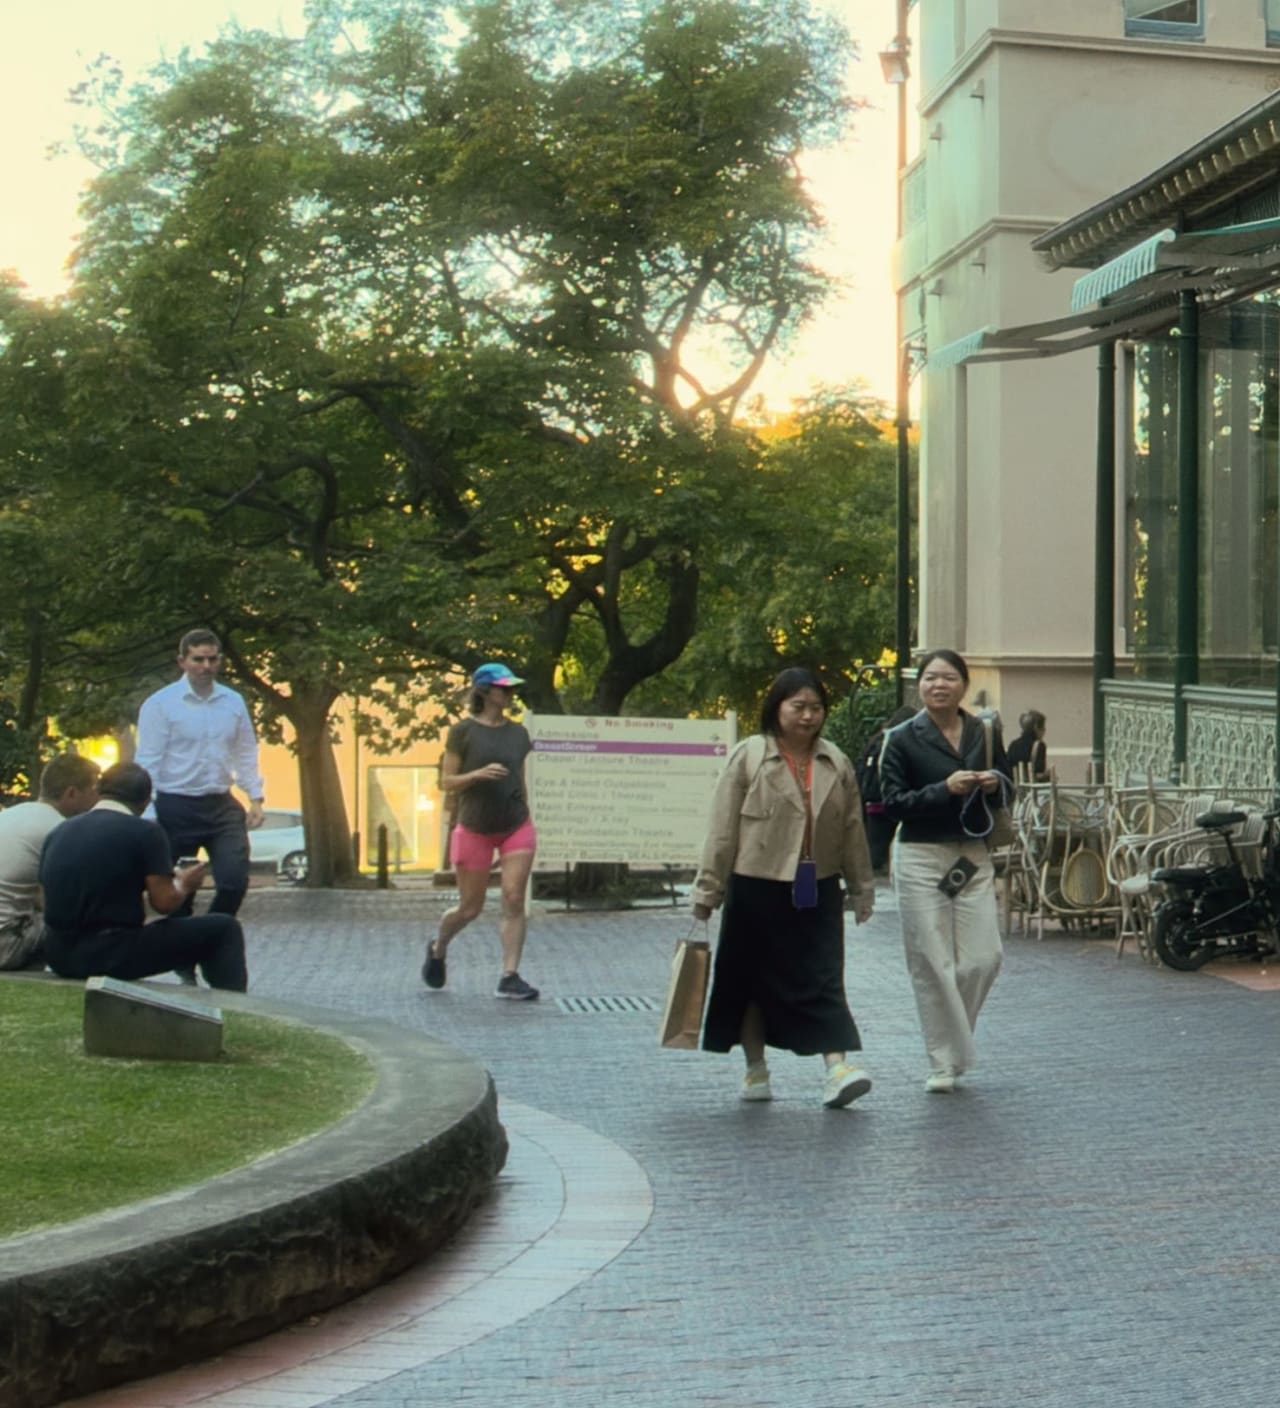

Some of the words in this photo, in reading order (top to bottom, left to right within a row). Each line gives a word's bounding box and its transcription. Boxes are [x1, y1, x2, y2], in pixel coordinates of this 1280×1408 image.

[604, 719, 620, 728] No
[625, 719, 674, 731] Smoking
[536, 729, 599, 739] Admissions
[536, 753, 577, 764] Chapel
[584, 754, 624, 764] Lecture
[629, 755, 669, 766] Theatre
[535, 778, 556, 788] Eye
[536, 802, 562, 811] Main
